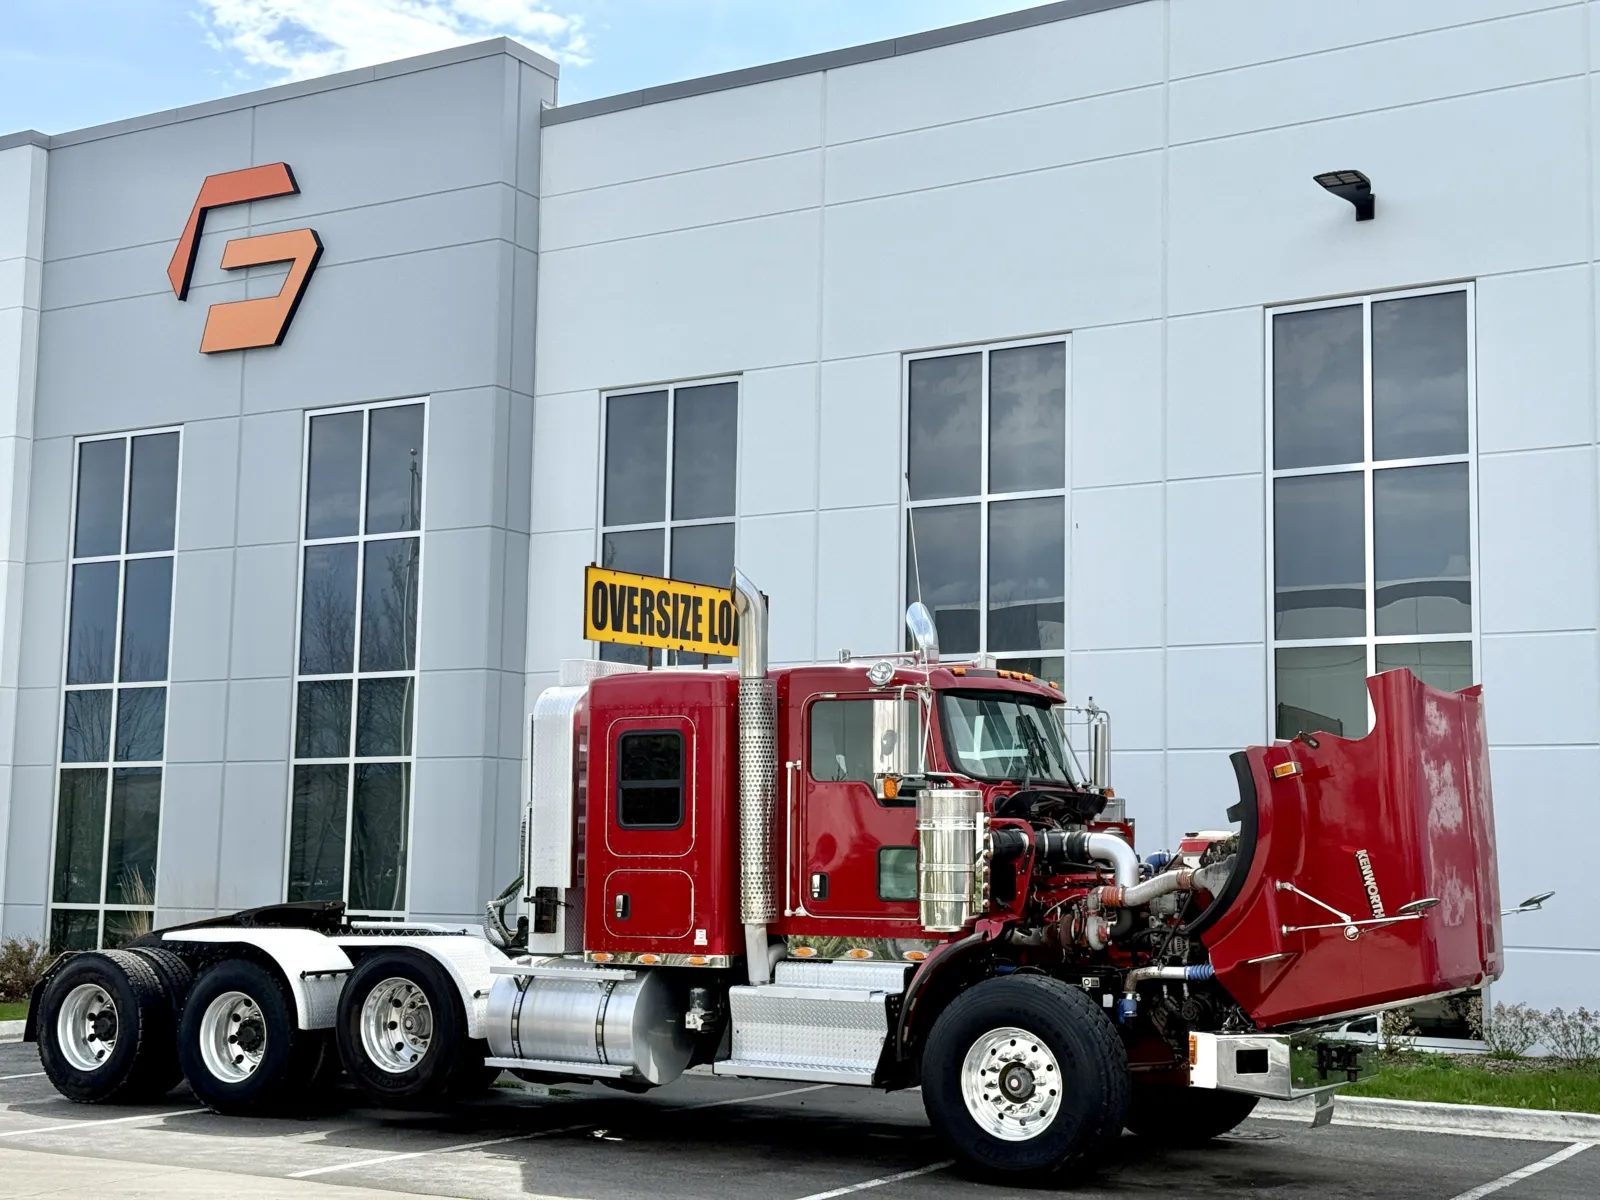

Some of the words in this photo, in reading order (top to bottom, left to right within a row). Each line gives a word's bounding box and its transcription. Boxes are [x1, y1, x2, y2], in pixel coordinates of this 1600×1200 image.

[591, 580, 703, 642] OVERSIZE
[708, 598, 739, 647] LO
[1356, 849, 1386, 919] KENWORTH
